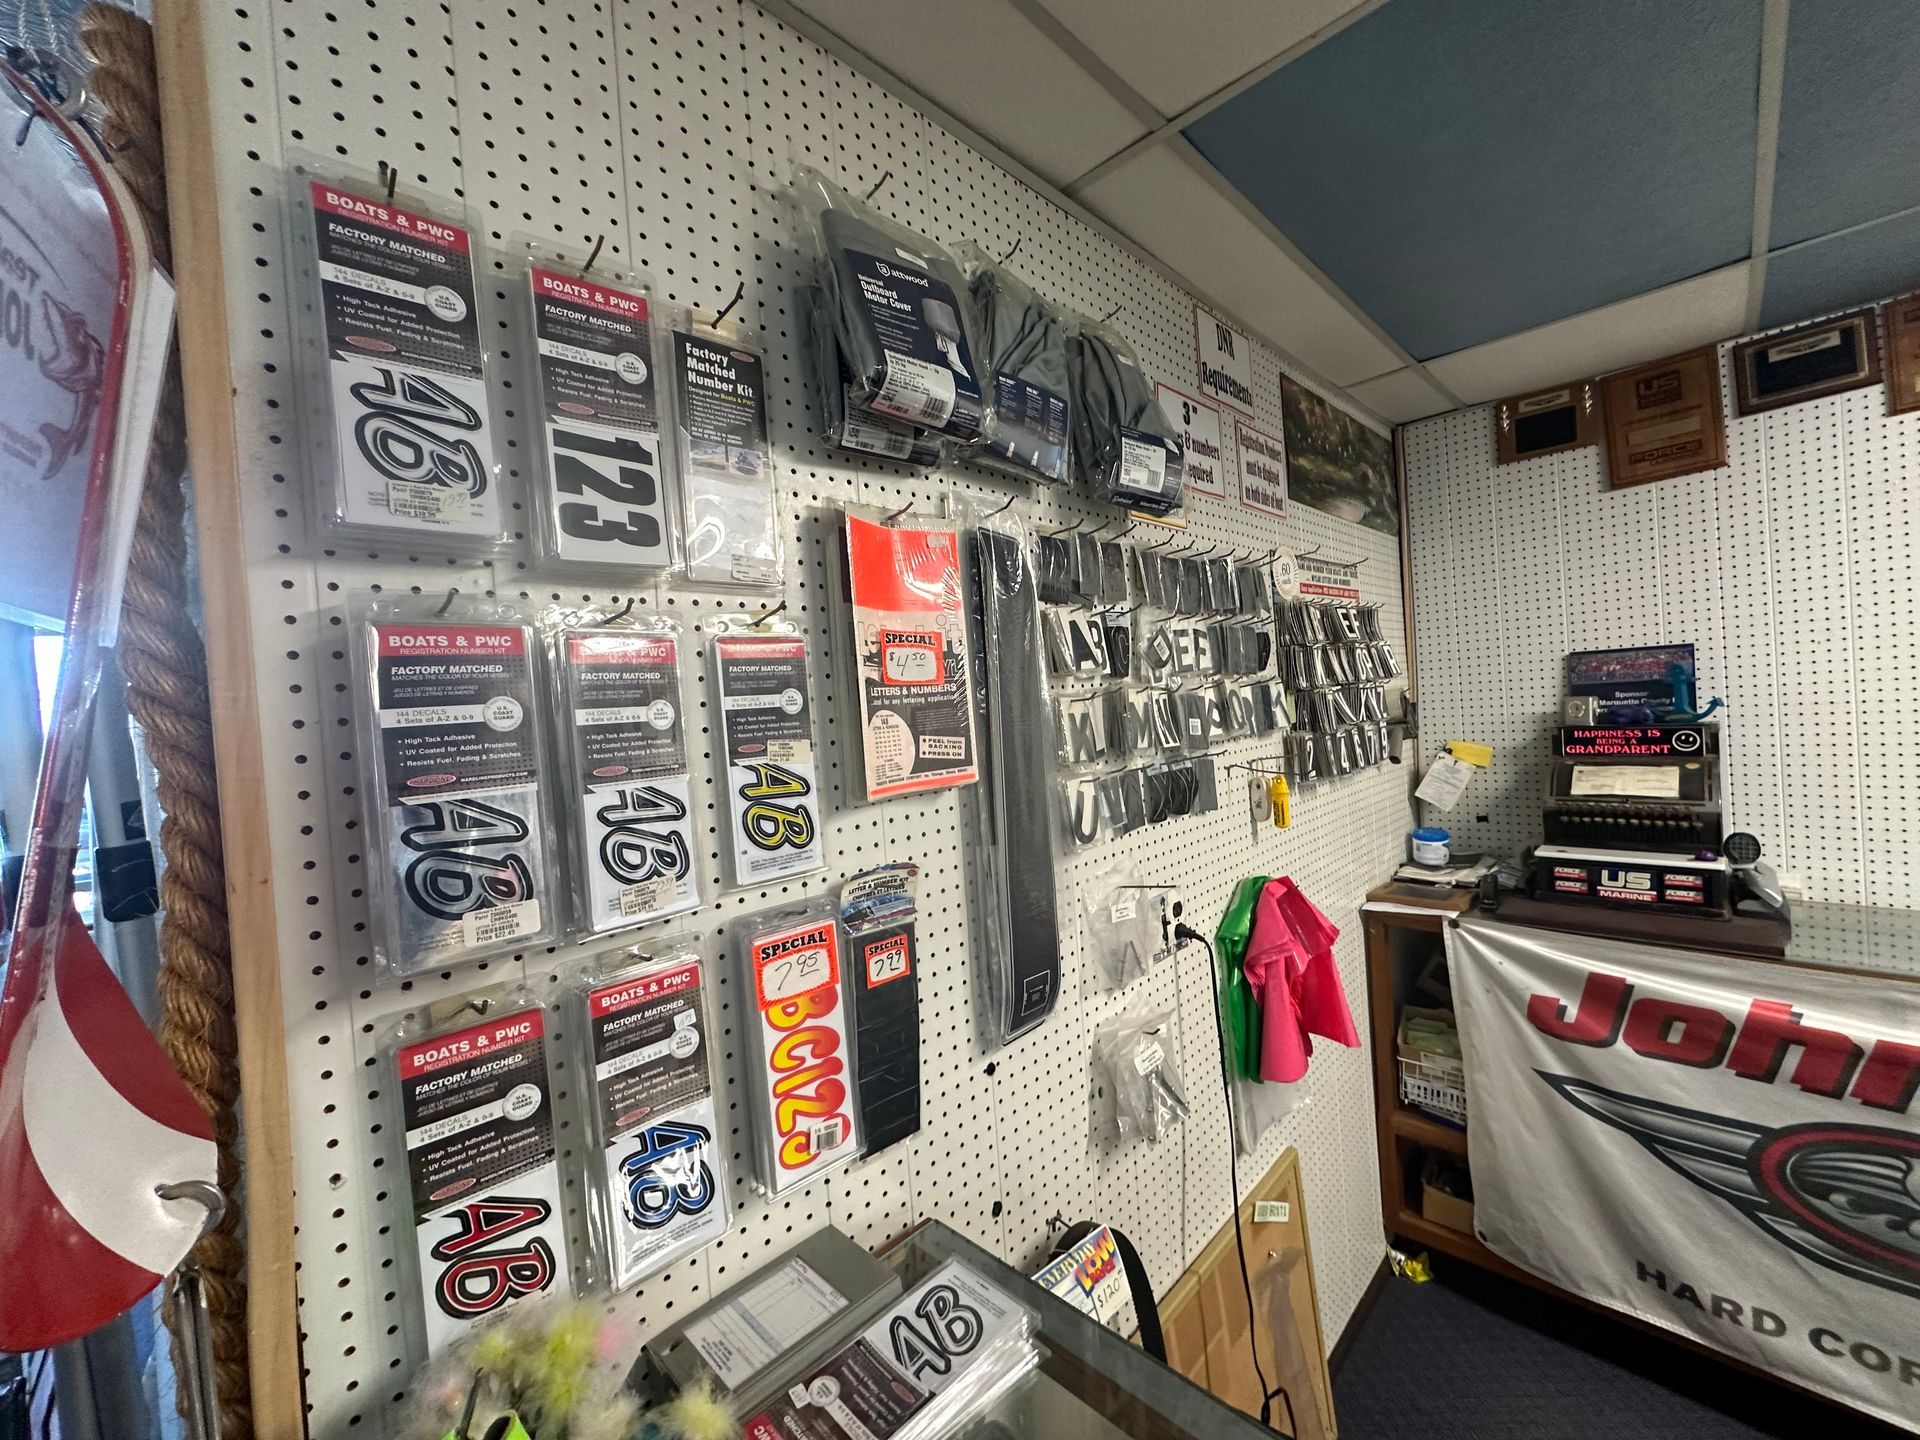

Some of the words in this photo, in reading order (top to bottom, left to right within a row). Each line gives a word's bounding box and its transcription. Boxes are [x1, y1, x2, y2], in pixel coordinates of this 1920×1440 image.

[326, 192, 388, 220] BOATS
[396, 215, 409, 228] &
[417, 220, 455, 241] PWC
[329, 223, 386, 245] FACTORY
[389, 240, 446, 263] MATCHED
[861, 281, 898, 299] Outboard
[891, 269, 929, 287] attwood
[543, 277, 589, 298] BOATS
[594, 292, 605, 303] &
[610, 296, 639, 312] PWC
[864, 290, 888, 304] Motor
[890, 298, 911, 311] Cover
[545, 305, 587, 321] FACTORY
[589, 317, 632, 333] MATCHED
[686, 342, 728, 366] Factory
[1216, 323, 1235, 360] DNR
[687, 357, 736, 380] Matched
[688, 370, 734, 392] Number
[737, 384, 753, 397] Kit
[688, 385, 712, 396] Designed
[1202, 361, 1253, 407] Requirements
[1183, 401, 1197, 426] 3"
[1192, 438, 1220, 461] numbers
[552, 428, 661, 547] 123
[1336, 607, 1358, 638] E
[1348, 608, 1360, 640] F
[389, 635, 449, 647] BOATS
[455, 635, 468, 646] &
[475, 635, 512, 646] PWC
[400, 647, 460, 655] REGISTRATION
[641, 648, 666, 656] PWC
[885, 633, 935, 646] SPECIAL
[1069, 620, 1100, 672] A
[1173, 629, 1193, 672] E
[1193, 628, 1208, 669] F
[391, 665, 446, 675] FACTORY
[449, 664, 503, 673] MATCHED
[1383, 645, 1401, 674] R
[581, 672, 621, 680] FACTORY
[871, 687, 900, 696] LETTERS
[902, 686, 908, 695] &
[911, 684, 956, 694] NUMBERS
[1360, 689, 1366, 721] X
[404, 717, 423, 725] Sets
[1574, 730, 1641, 738] HAPPINESS
[405, 738, 423, 746] High
[419, 746, 445, 754] Coated
[460, 743, 482, 751] Added
[485, 741, 517, 749] Protection
[1341, 737, 1350, 772] 4
[1566, 745, 1670, 754] GRANDPARENT
[407, 759, 434, 767] Resists
[456, 754, 480, 763] Fading
[489, 751, 521, 759] Scratches
[460, 771, 528, 782] HARDLINEPRODUCTS.COM
[739, 762, 814, 851] AB
[1073, 790, 1100, 844] U
[849, 884, 866, 895] LETTER
[1601, 869, 1651, 889] US
[1600, 890, 1652, 901] MARINE
[761, 930, 827, 962] SPECIAL
[868, 938, 905, 956] SPECIAL
[601, 986, 645, 1007] BOATS
[650, 981, 658, 992] &
[664, 972, 691, 987] PWC
[603, 1013, 642, 1032] FACTORY
[644, 1000, 684, 1017] MATCHED
[413, 1040, 470, 1067] BOATS
[477, 1035, 488, 1047] &
[496, 1022, 531, 1041] PWC
[424, 1049, 480, 1072] REGISTRATION
[482, 1041, 513, 1056] NUMBER
[515, 1036, 525, 1045] KIT
[415, 1071, 467, 1095] FACTORY
[470, 1053, 522, 1076] MATCHED
[431, 1196, 556, 1320] AB
[1039, 1242, 1095, 1289] EVERYDAY
[1075, 1229, 1115, 1298] LOW
[1636, 1259, 1786, 1338] HARD
[889, 1284, 984, 1382] AB
